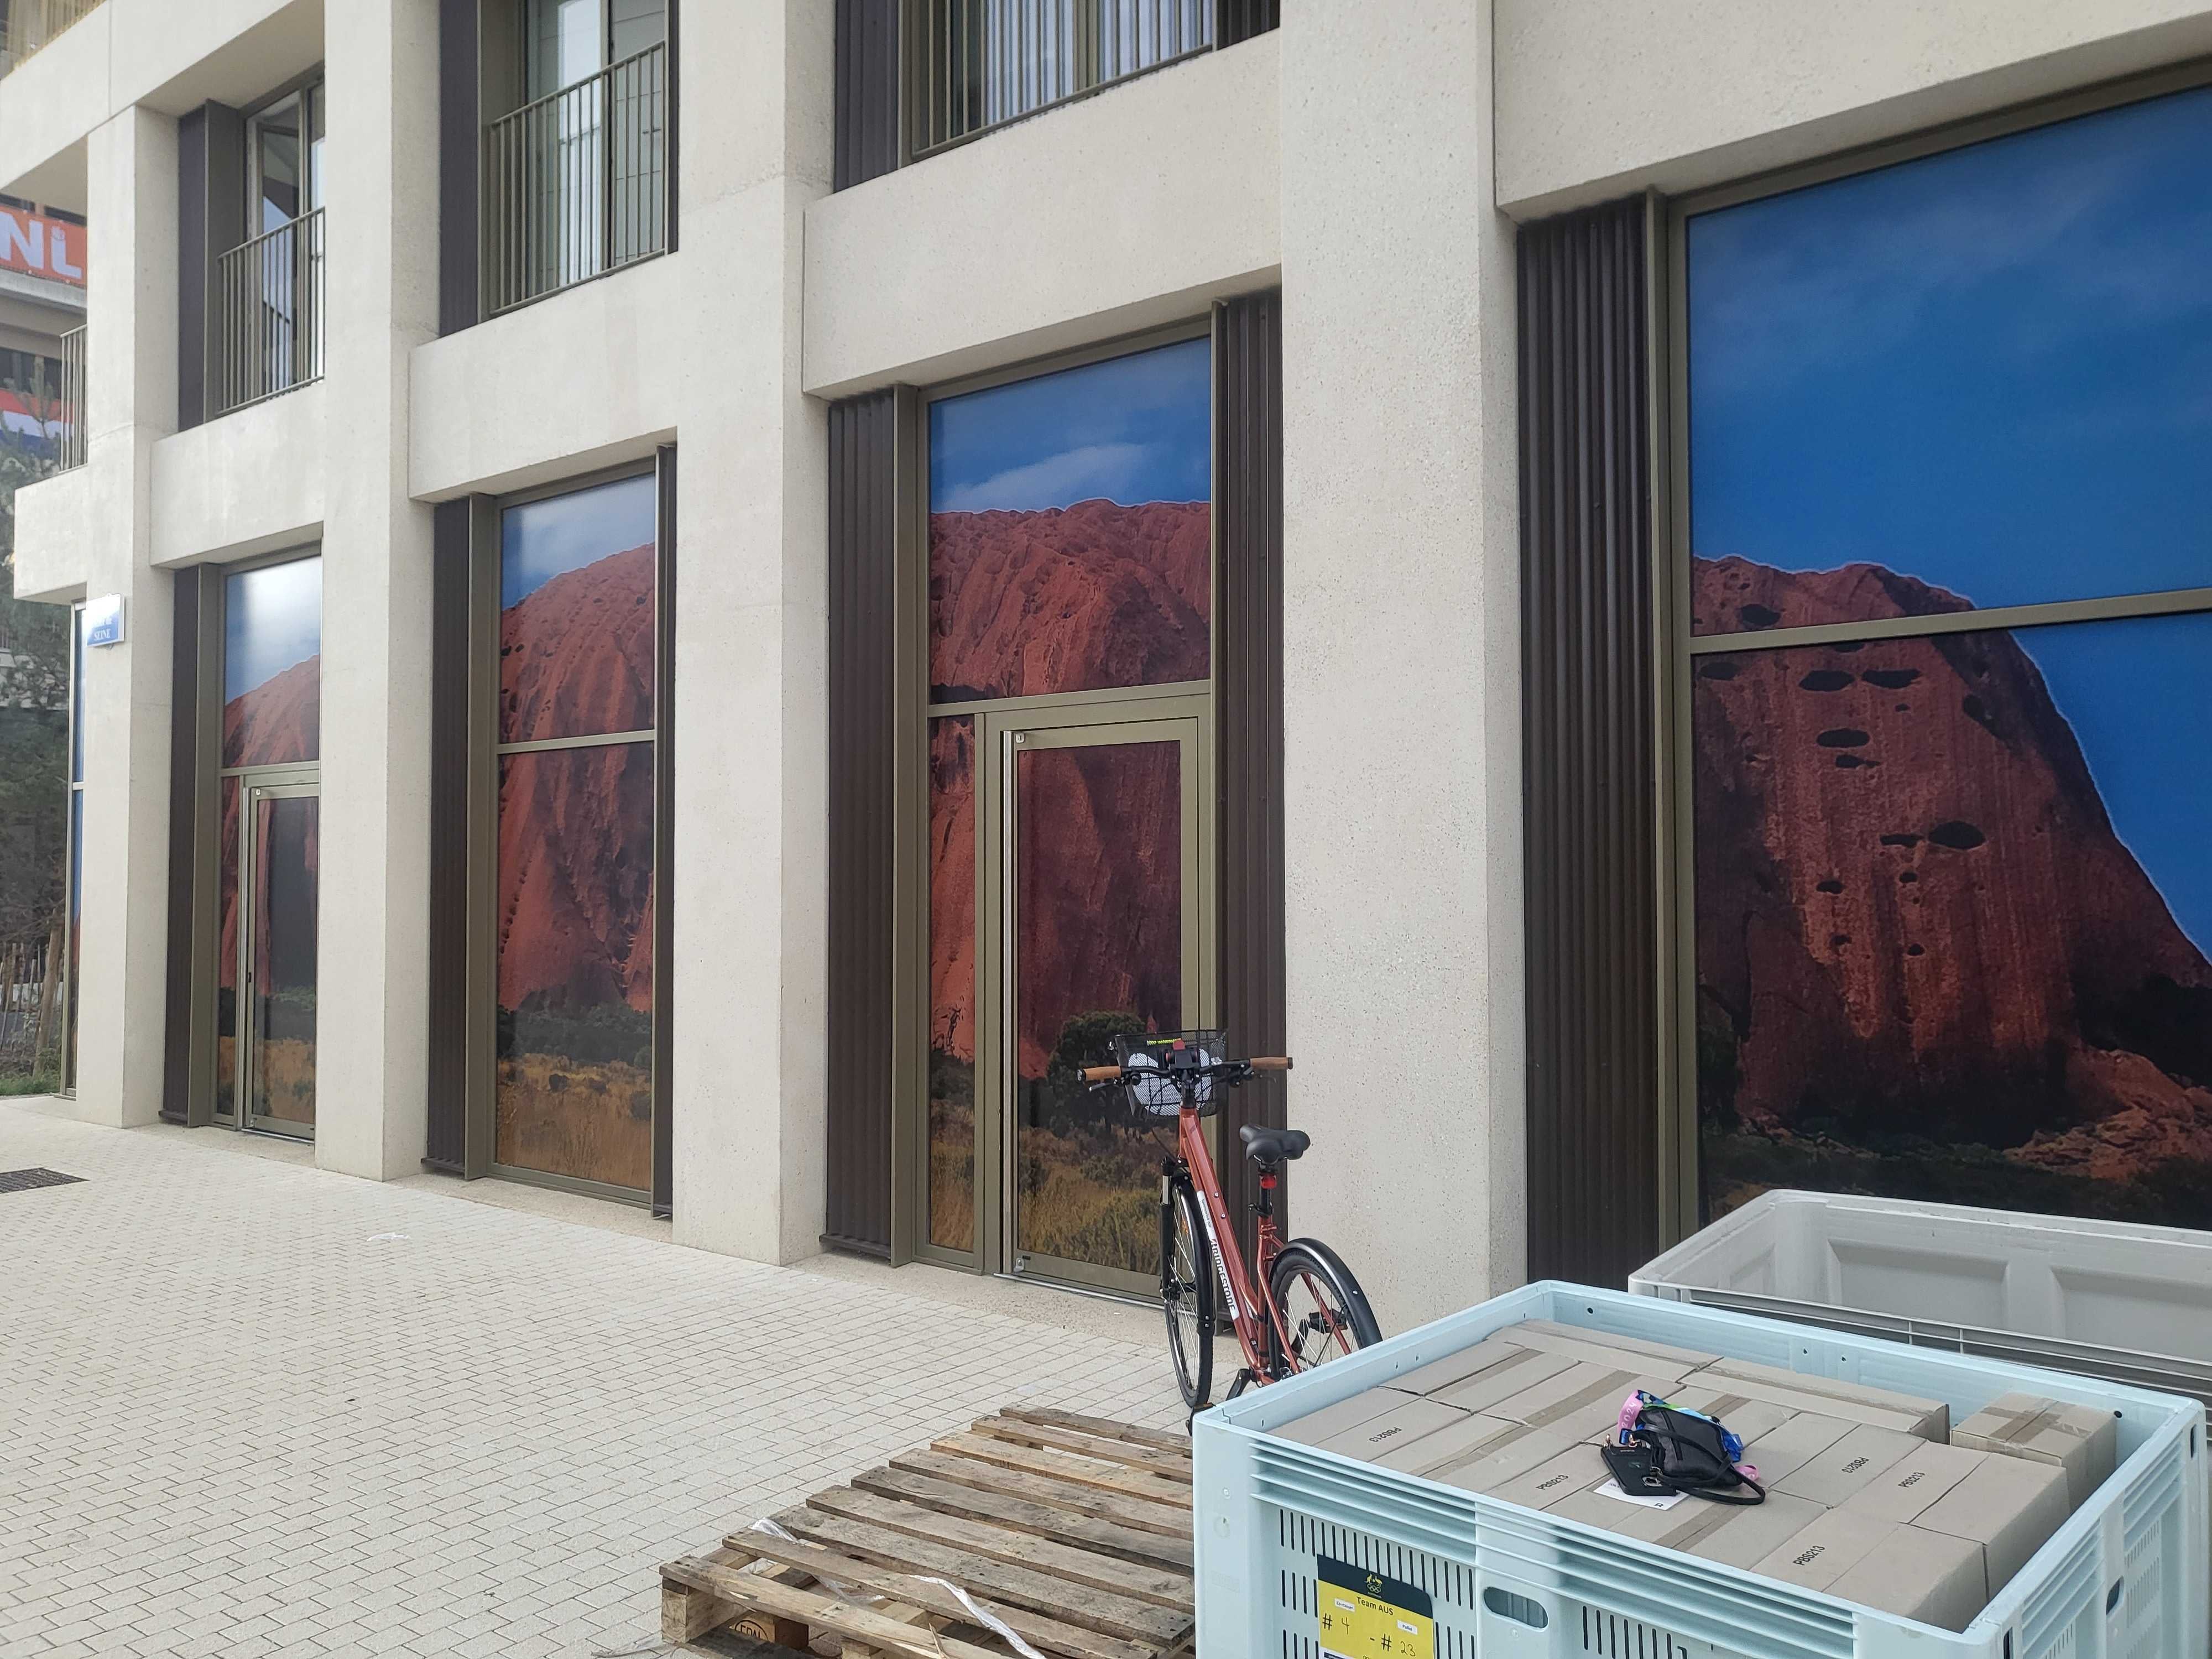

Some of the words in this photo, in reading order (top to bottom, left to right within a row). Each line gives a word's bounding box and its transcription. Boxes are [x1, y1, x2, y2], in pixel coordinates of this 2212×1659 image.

[0, 211, 82, 279] NL
[93, 629, 111, 641] SEINE
[1621, 1402, 1637, 1427] 2024
[1369, 1427, 1402, 1442] PBS213
[1841, 1457, 1869, 1473] PBS213
[1535, 1475, 1568, 1490] PBS213
[1897, 1472, 1925, 1488] PBS213
[1792, 1546, 1825, 1566] PBS213
[1357, 1597, 1376, 1610] Team
[1379, 1604, 1394, 1615] AUS
[1400, 1641, 1416, 1657] 23
